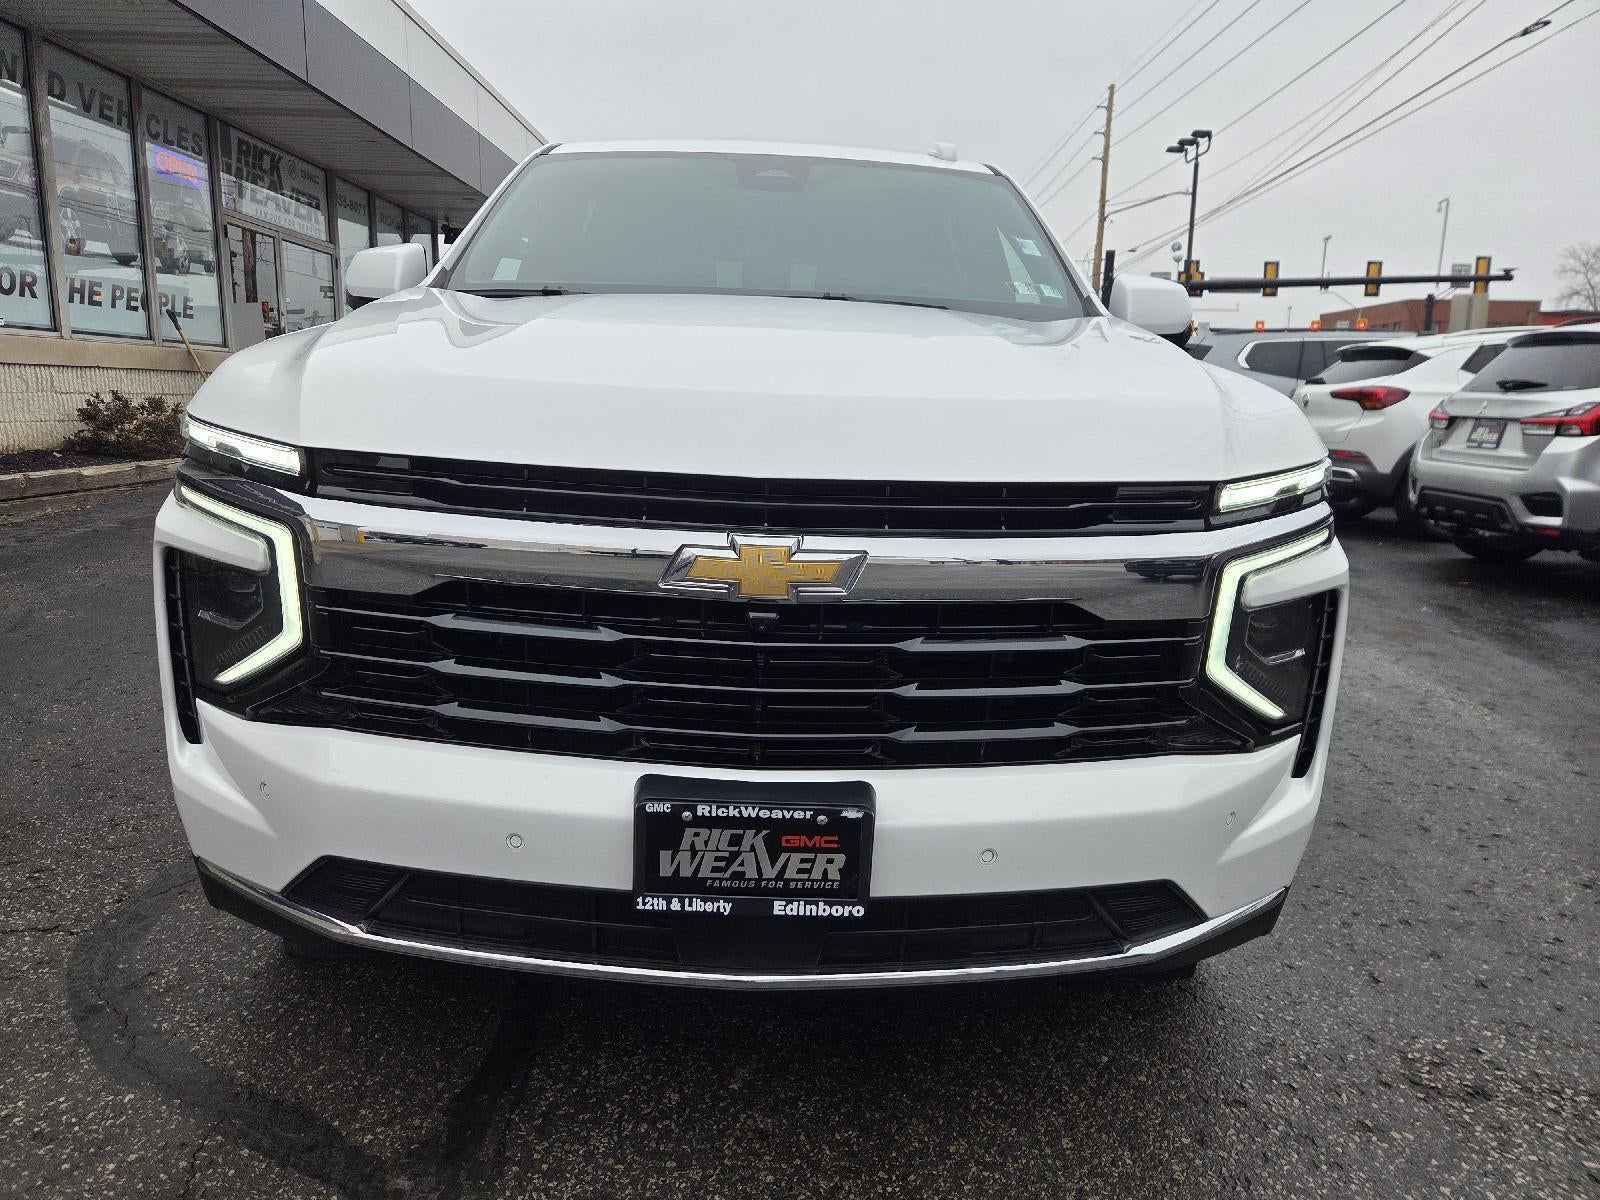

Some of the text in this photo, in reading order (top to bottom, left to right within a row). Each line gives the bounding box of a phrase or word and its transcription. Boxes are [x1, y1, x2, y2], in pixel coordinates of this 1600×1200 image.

[77, 81, 203, 157] VEHCLES
[66, 276, 103, 308] HE
[645, 803, 814, 820] GMC RickWeaver
[679, 827, 770, 852] RICK
[781, 835, 840, 848] GMC
[659, 849, 846, 880] WEAVER
[706, 879, 840, 890] FAMOUS FOR SERVICE
[636, 896, 865, 917] 12th & Liberty Edinboro
